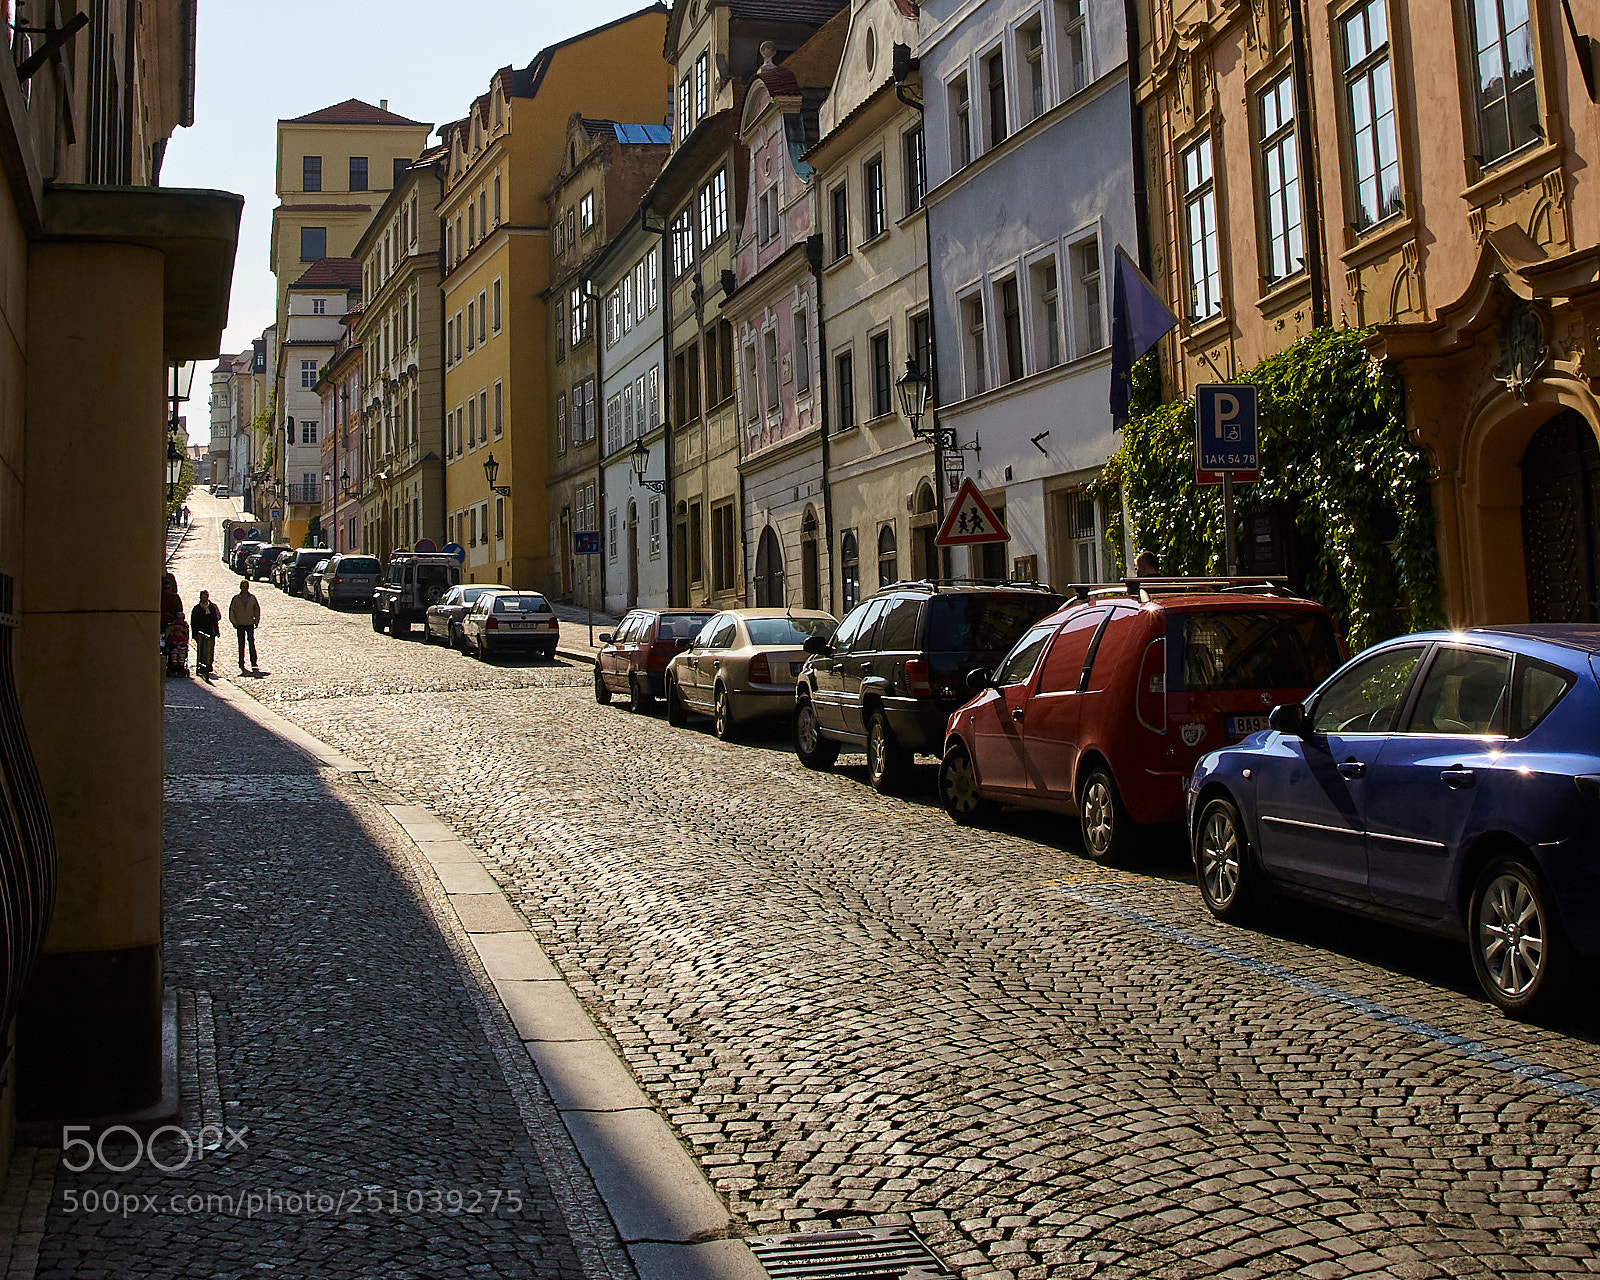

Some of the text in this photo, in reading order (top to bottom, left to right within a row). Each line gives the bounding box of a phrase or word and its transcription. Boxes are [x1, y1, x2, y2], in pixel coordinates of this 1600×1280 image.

[1214, 392, 1240, 439] P
[1205, 454, 1256, 464] 1AK 54 78
[1238, 718, 1261, 732] 8A9
